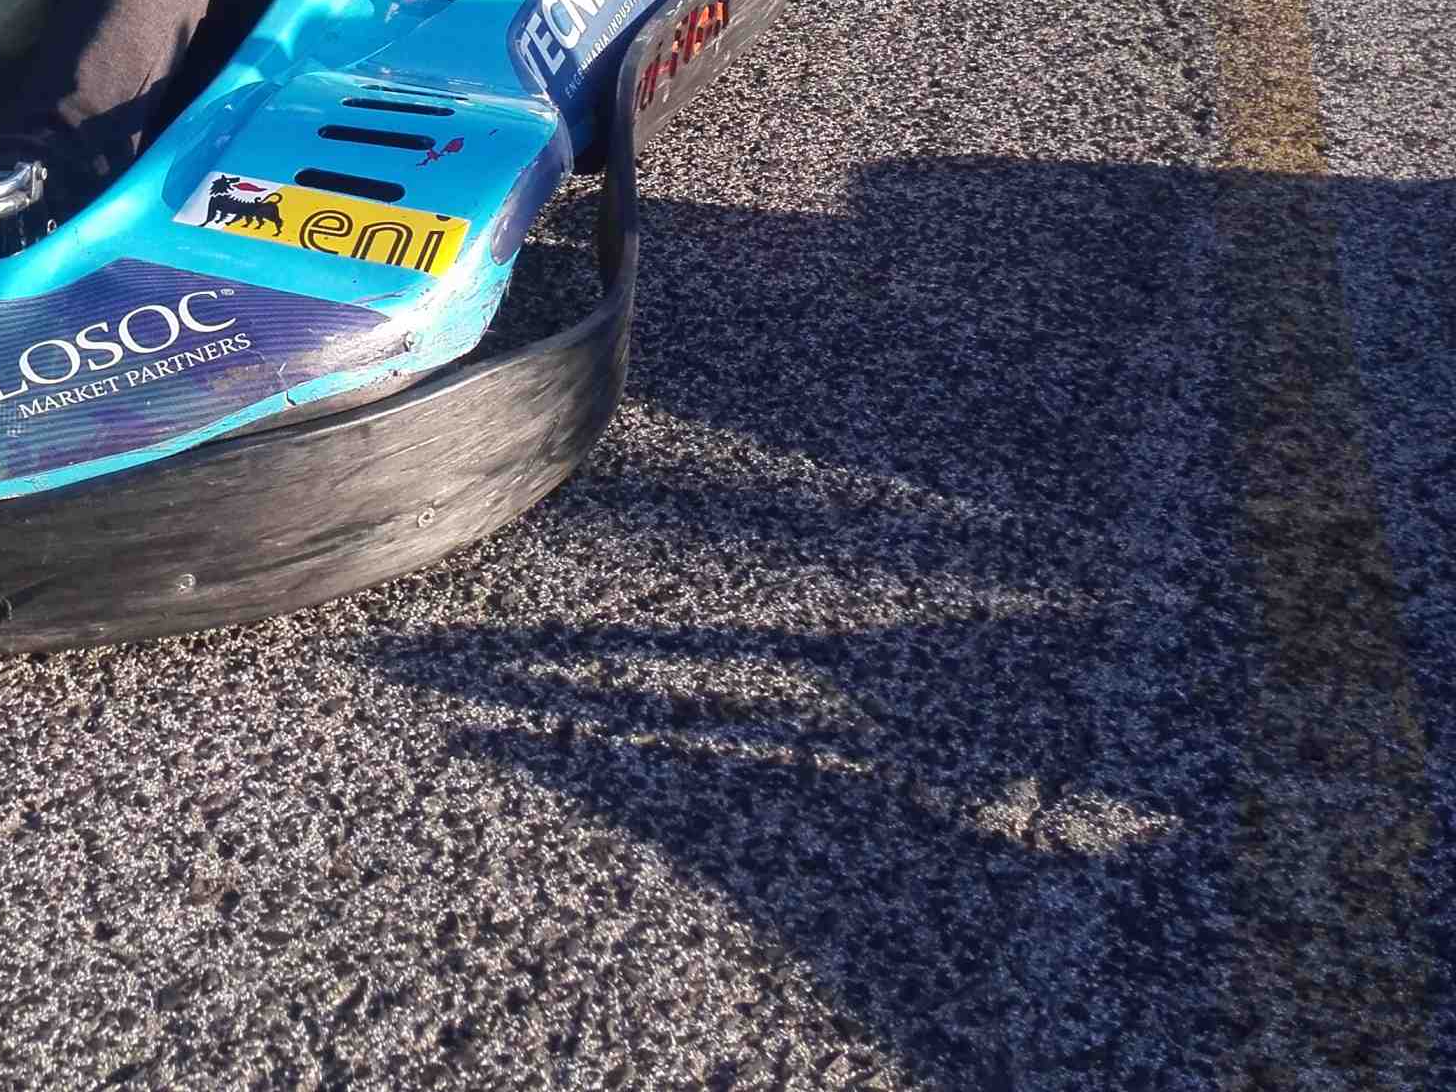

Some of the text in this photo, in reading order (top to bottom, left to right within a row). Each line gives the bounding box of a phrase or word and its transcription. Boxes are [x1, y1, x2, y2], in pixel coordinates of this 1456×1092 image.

[298, 207, 453, 274] eni
[19, 332, 252, 419] MARKET PARTNERS
